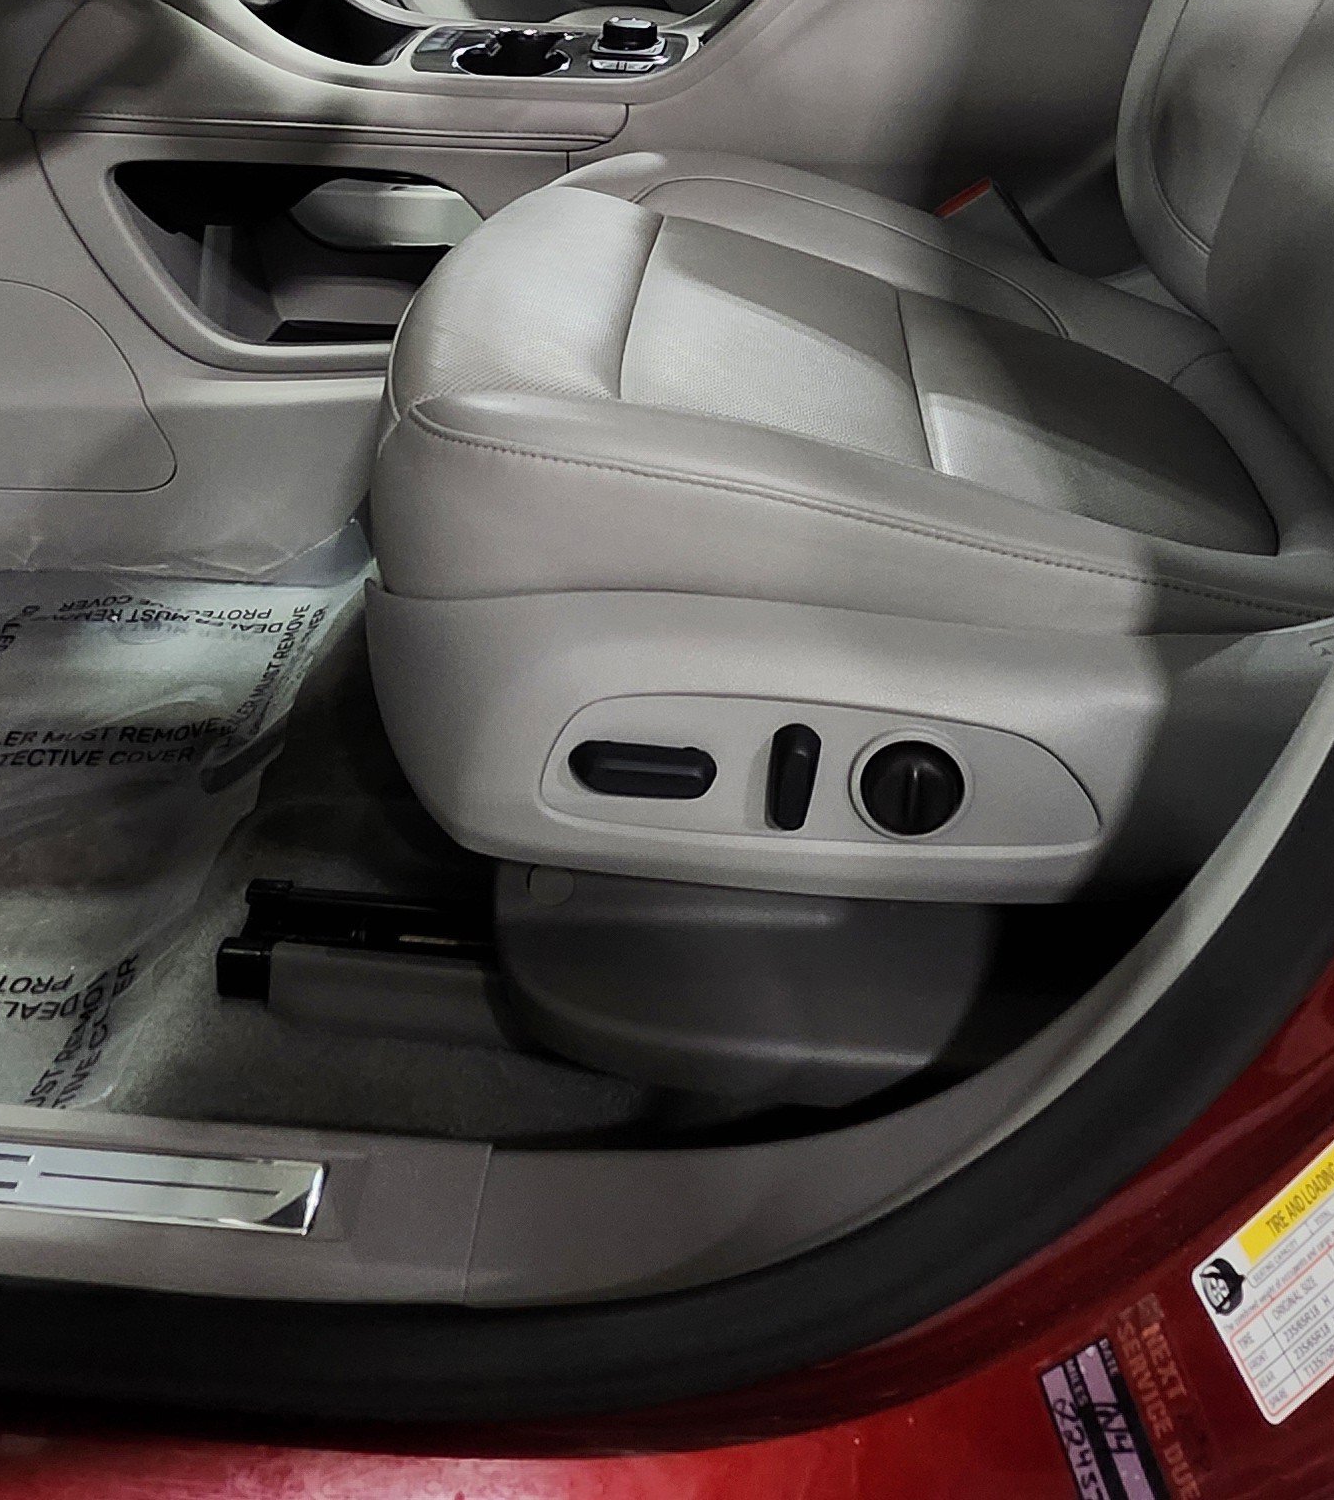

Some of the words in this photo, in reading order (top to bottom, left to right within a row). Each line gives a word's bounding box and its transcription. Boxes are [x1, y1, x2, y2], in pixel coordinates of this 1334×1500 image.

[272, 603, 312, 660] REMOVE
[118, 716, 221, 744] REMOVE
[108, 746, 196, 767] COVER
[1265, 1208, 1289, 1238] TIRE
[1282, 1192, 1307, 1221] AND
[1270, 1286, 1303, 1322] ORIGINAL
[1299, 1273, 1318, 1295] SIZE
[1118, 1322, 1174, 1442] SERVICE
[1164, 1441, 1202, 1500] DUE
